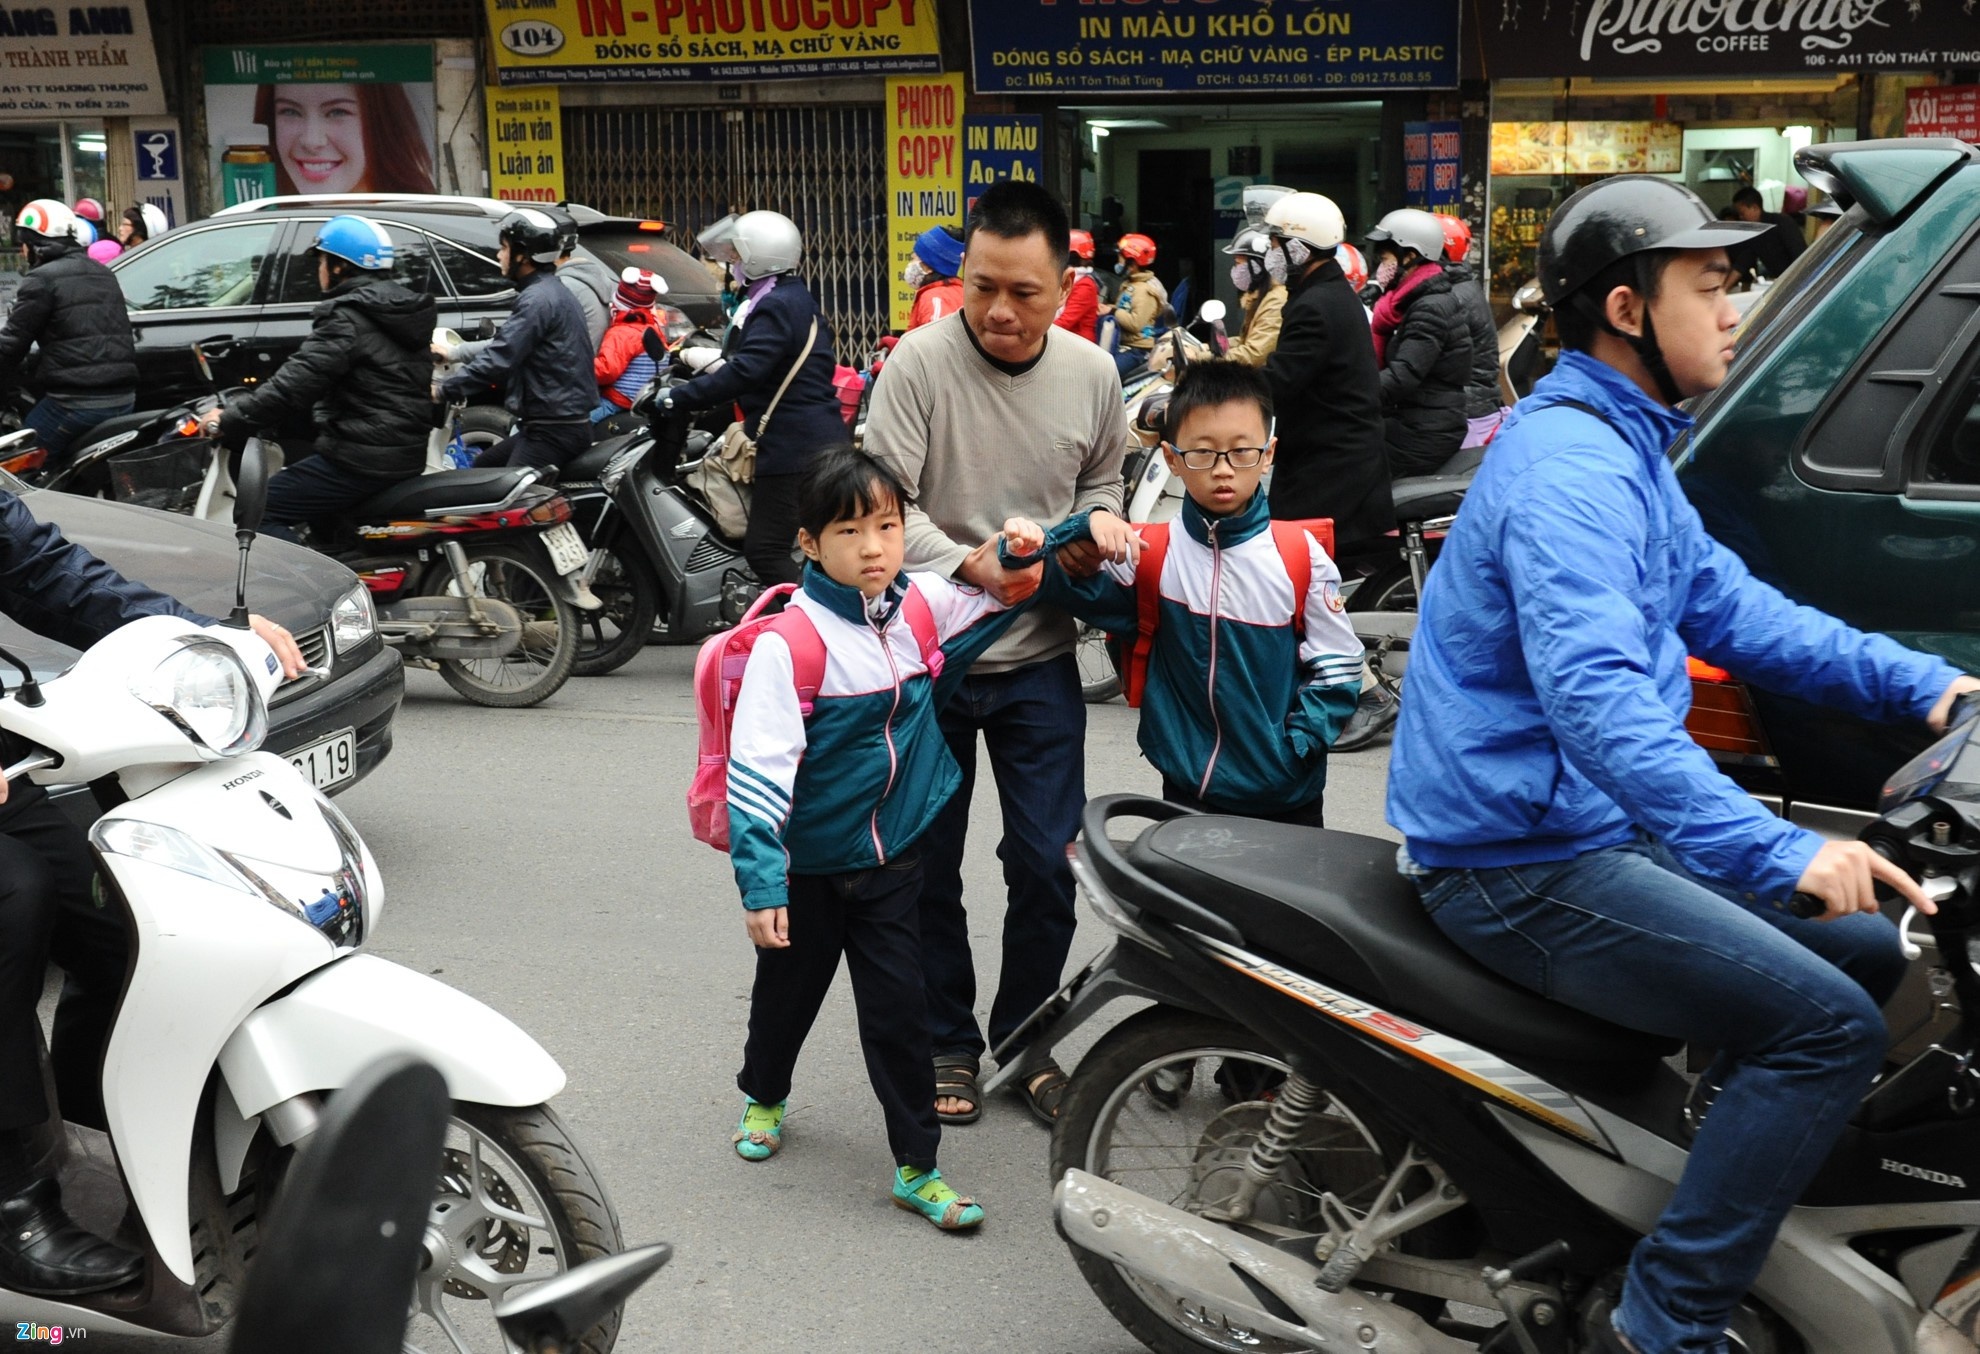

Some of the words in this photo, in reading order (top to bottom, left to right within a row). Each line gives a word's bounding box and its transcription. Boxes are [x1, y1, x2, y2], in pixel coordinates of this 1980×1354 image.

[70, 7, 133, 34] ANH
[1079, 16, 1111, 39] IN
[1121, 10, 1196, 39] MÀU
[1208, 1, 1275, 37] KHỔ
[1286, 7, 1351, 36] LỚN
[510, 28, 556, 47] 104
[596, 40, 652, 59] ĐÓNG
[657, 35, 682, 58] SỔ
[688, 37, 748, 59] SÁCH,
[753, 40, 785, 58] MẠ
[790, 33, 835, 53] CHỮ
[840, 32, 901, 50] VÀNG
[1696, 35, 1769, 52] COFFEE
[5, 46, 71, 68] THÀNH
[75, 40, 129, 66] PHẨM
[232, 51, 257, 73] Wit
[992, 47, 1050, 66] ĐÓNG
[1056, 42, 1084, 66] SỔ
[1089, 46, 1144, 65] SÁCH
[1161, 49, 1195, 69] MẠ
[1200, 44, 1243, 64] CHỮ
[1249, 44, 1309, 64] VÀNG
[1326, 43, 1352, 62] ÉP
[1358, 45, 1445, 62] PLASTIC
[1804, 54, 1825, 66] 106
[1837, 53, 1862, 65] A11
[1900, 48, 1937, 63] THẤT
[1027, 72, 1053, 86] 105
[1056, 76, 1076, 86] A11
[1080, 75, 1102, 85] Tôn
[1106, 72, 1131, 85] Thất
[1135, 74, 1163, 87] Tùng
[897, 84, 955, 127] PHOTO
[1907, 89, 1938, 125] XÔI
[496, 117, 527, 147] Luận
[530, 117, 553, 141] văn
[968, 126, 988, 151] IN
[994, 121, 1038, 151] MÀU
[1431, 132, 1460, 160] PHOTO
[499, 151, 532, 180] Luận
[537, 150, 554, 174] án
[898, 135, 956, 177] COPY
[1433, 163, 1458, 191] COPY
[897, 191, 913, 217] IN
[920, 186, 957, 217] MÀU
[222, 769, 265, 791] HONDA
[1880, 1158, 1966, 1188] HONDA
